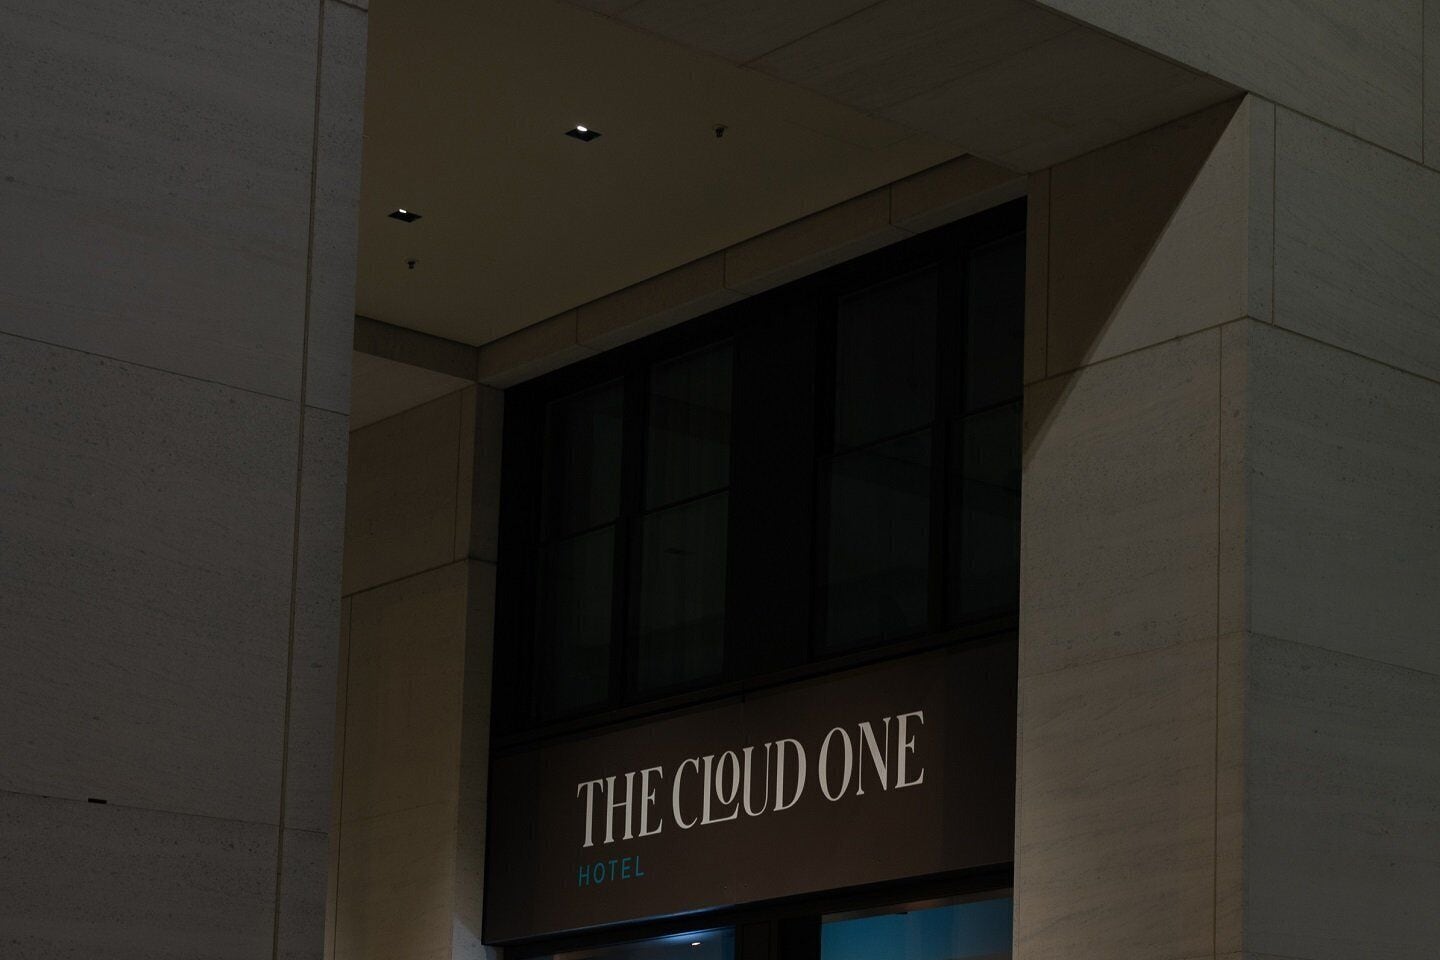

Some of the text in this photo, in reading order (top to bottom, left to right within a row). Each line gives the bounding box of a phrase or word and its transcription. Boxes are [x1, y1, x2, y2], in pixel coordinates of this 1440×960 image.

[576, 710, 925, 848] THE CLOUD ONE
[577, 854, 646, 888] HOTEL
